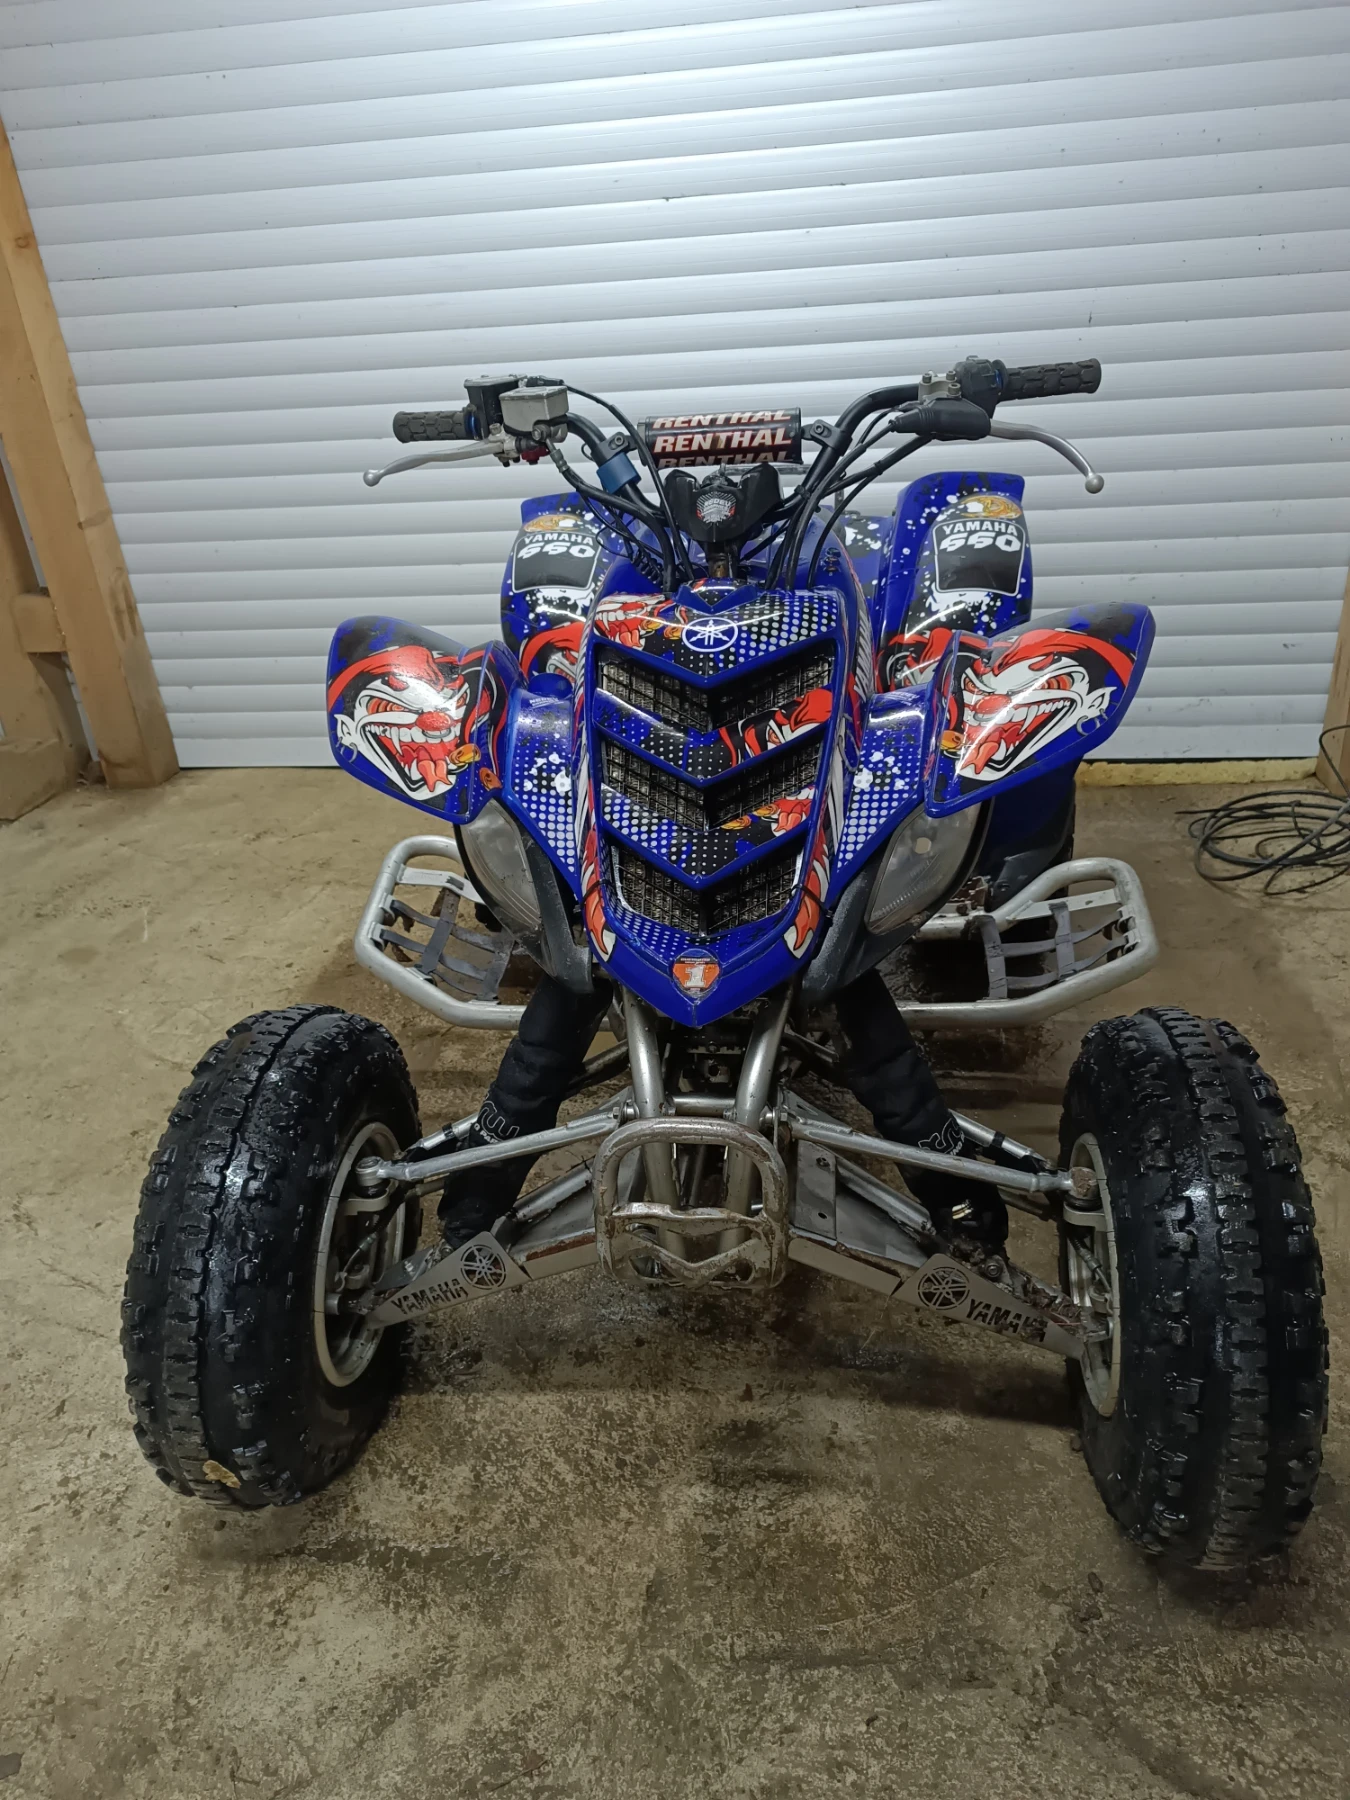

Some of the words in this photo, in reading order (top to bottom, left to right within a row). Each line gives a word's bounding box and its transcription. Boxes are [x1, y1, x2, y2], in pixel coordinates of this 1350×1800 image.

[652, 410, 791, 429] RENTHAL
[653, 427, 792, 453] RENTHAL
[942, 521, 1018, 536] YAMAHA
[523, 533, 594, 546] YAMAHA
[391, 1278, 469, 1315] YAMAHA
